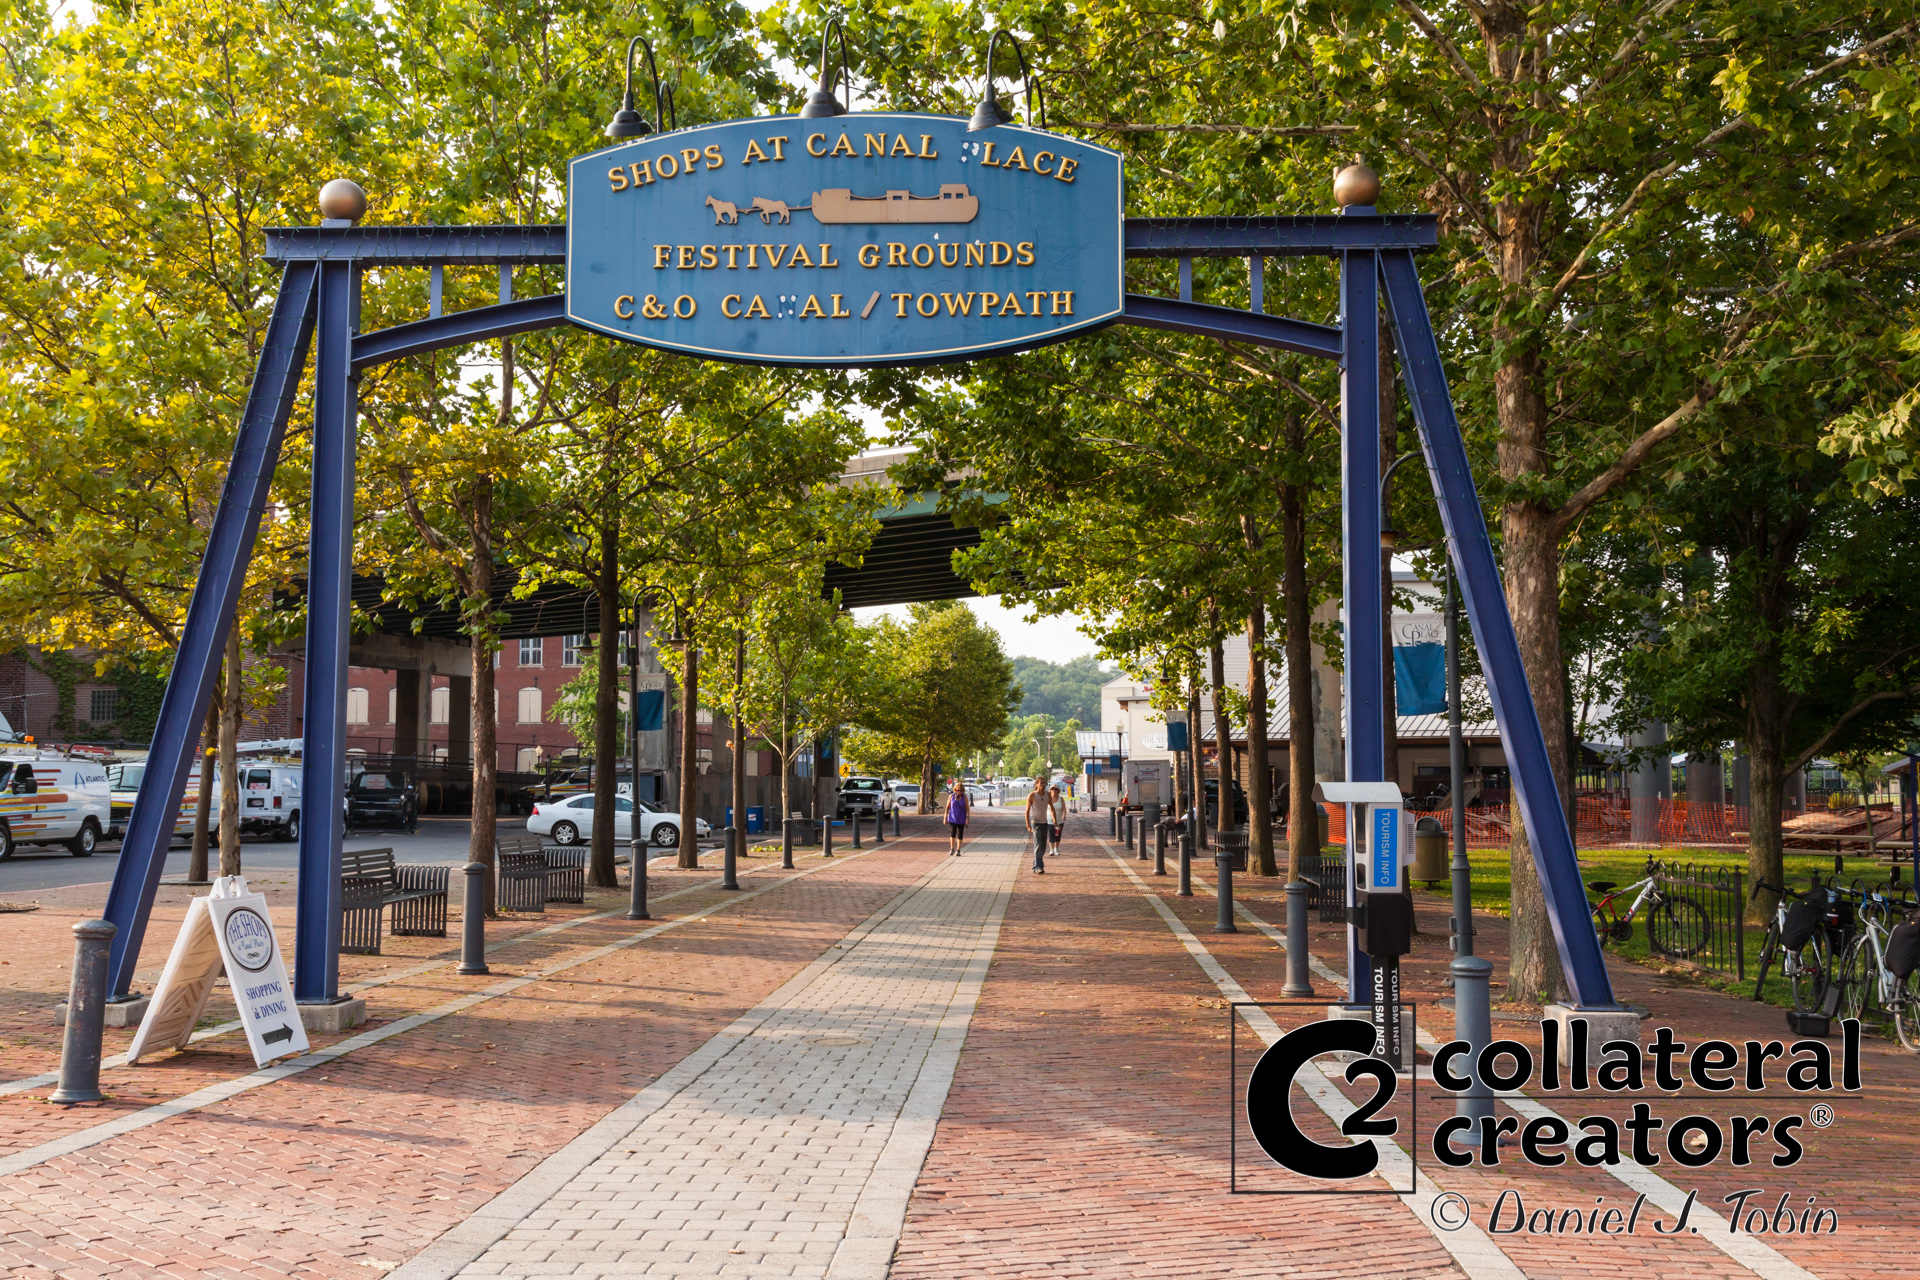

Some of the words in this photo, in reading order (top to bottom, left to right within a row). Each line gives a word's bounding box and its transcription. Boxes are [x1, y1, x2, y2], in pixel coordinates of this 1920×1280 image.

[608, 144, 725, 193] SHOPS
[742, 135, 788, 165] AT
[806, 132, 939, 160] CANAL
[652, 243, 839, 270] FESTIVAL
[858, 241, 1036, 269] GROUNDS
[614, 294, 697, 320] C&O
[891, 290, 1076, 318] TOWPATH
[1402, 624, 1432, 639] CANAL
[1412, 630, 1441, 647] PLACE
[1381, 812, 1390, 857] TOURISM
[1381, 861, 1390, 885] INFO
[228, 916, 243, 945] THE
[240, 913, 268, 939] SHOPS
[246, 981, 282, 1000] SHOPPING
[1374, 966, 1384, 1022] TOURISM
[253, 1008, 261, 1019] &
[261, 1001, 287, 1017] DINING
[1376, 1025, 1386, 1055] INFO
[1392, 1026, 1400, 1056] INFO
